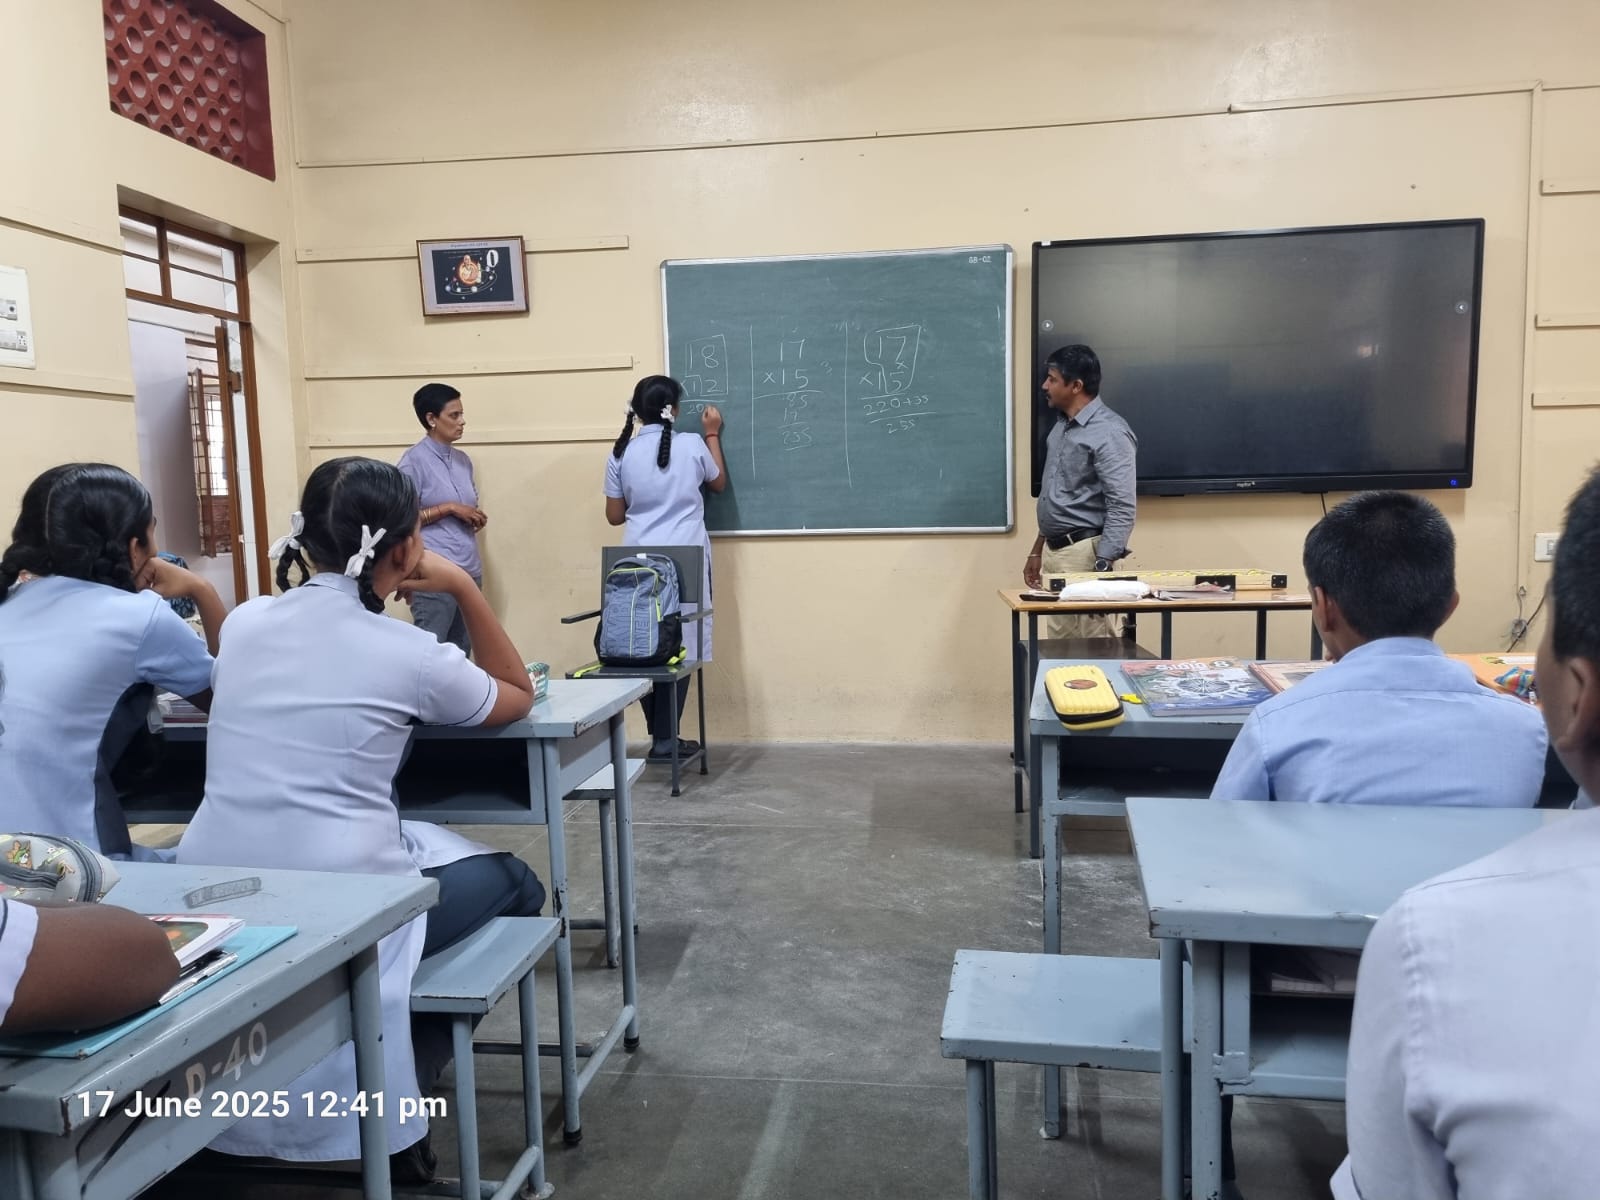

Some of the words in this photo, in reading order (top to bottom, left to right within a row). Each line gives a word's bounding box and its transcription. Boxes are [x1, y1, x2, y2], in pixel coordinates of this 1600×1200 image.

[689, 343, 719, 368] 18
[780, 338, 806, 362] 17
[878, 335, 906, 361] 17
